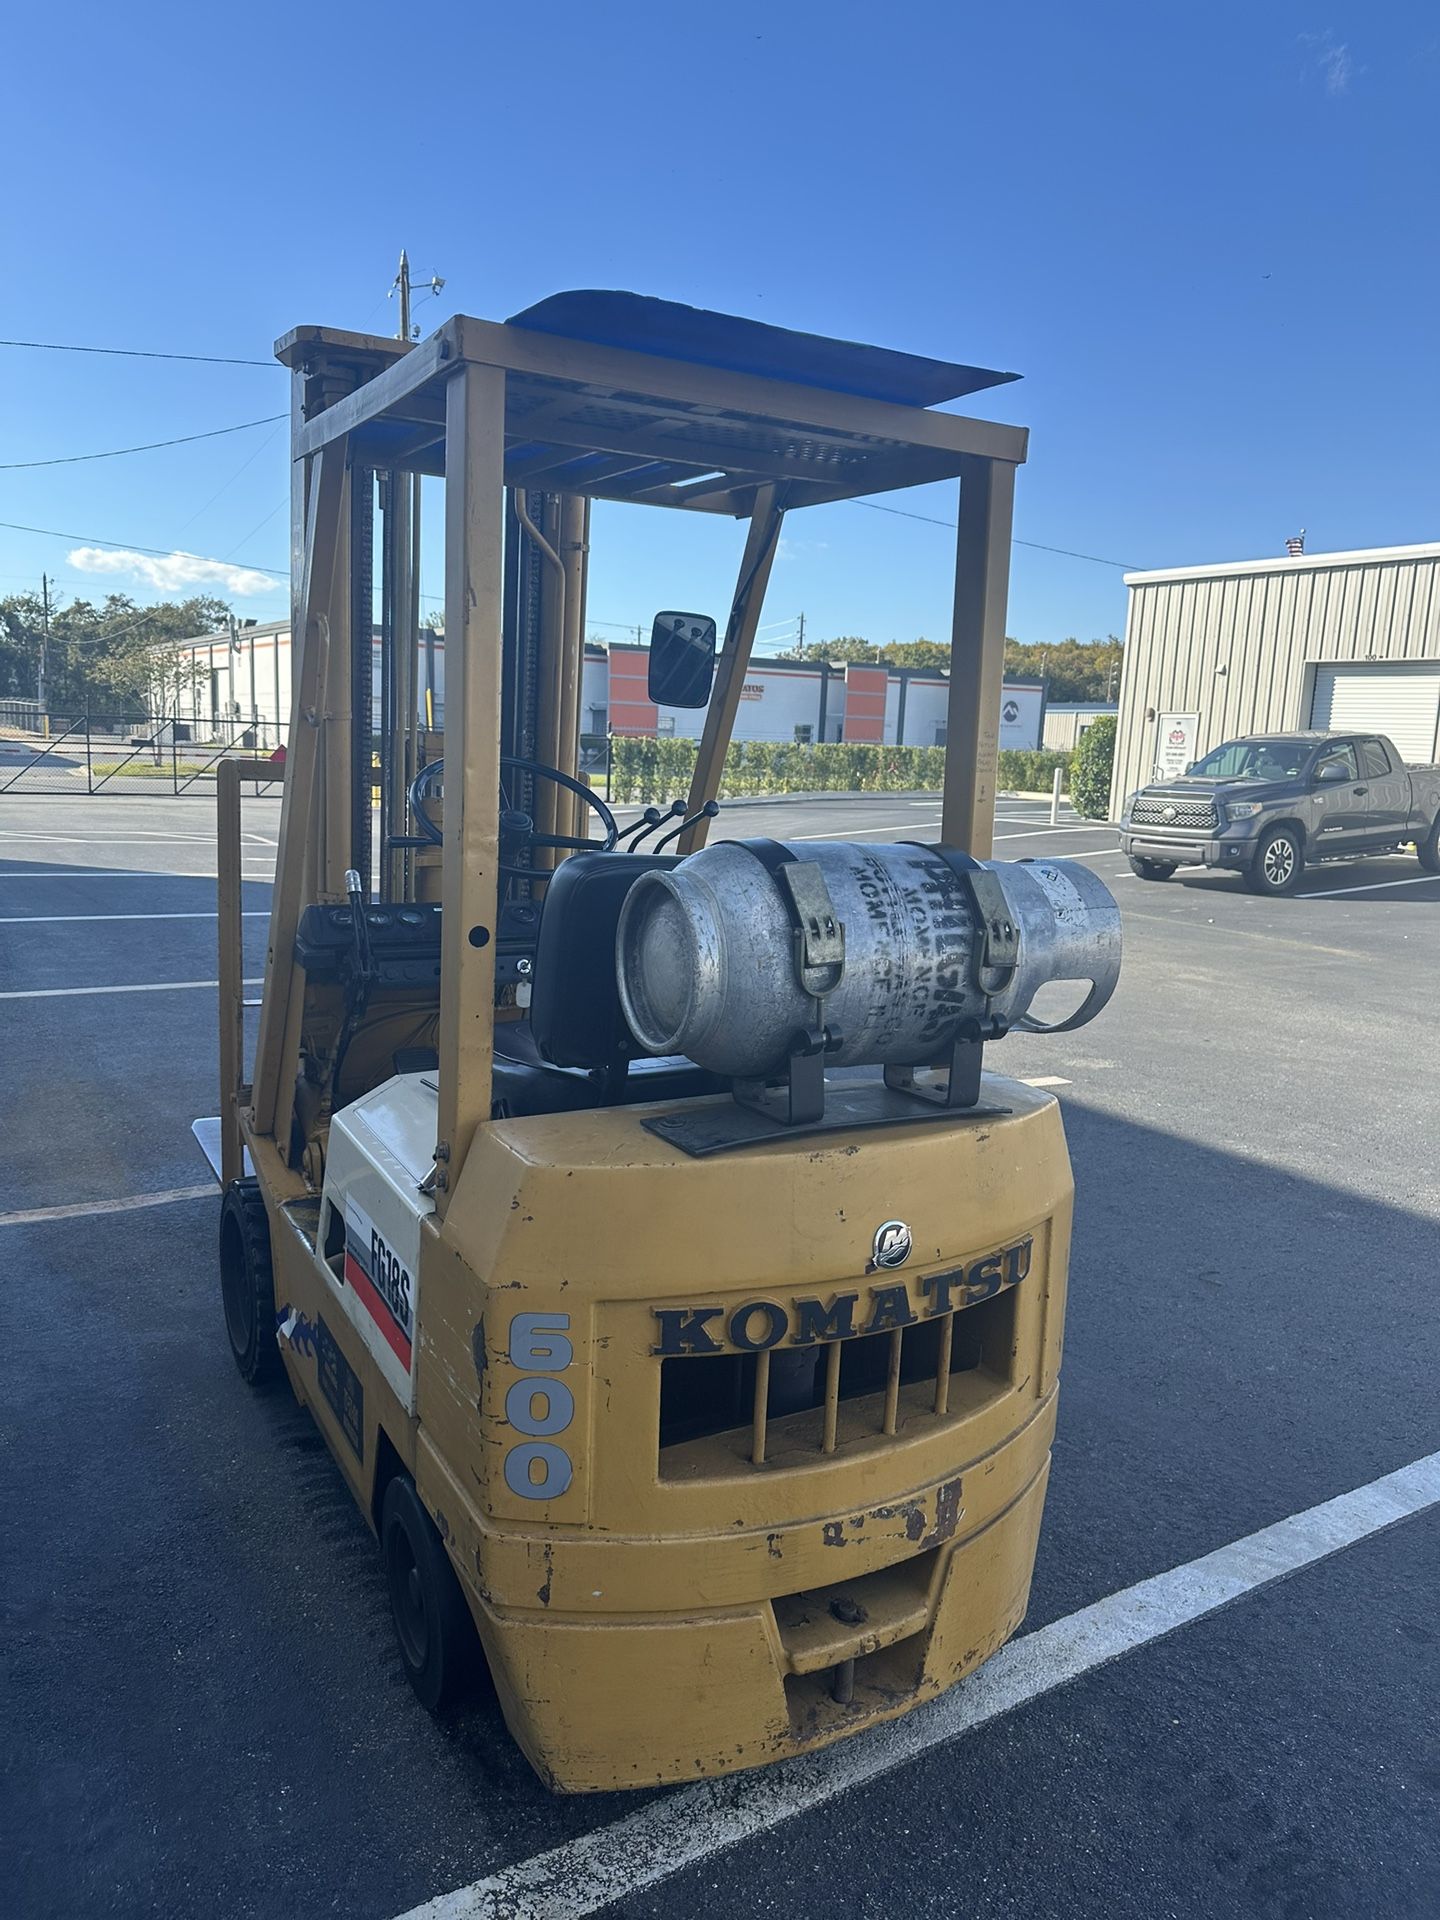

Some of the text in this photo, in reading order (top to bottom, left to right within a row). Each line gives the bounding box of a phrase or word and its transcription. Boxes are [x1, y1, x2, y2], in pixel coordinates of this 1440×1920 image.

[371, 1227, 410, 1327] FG18S
[650, 1233, 1034, 1356] KOMATSU
[504, 1312, 575, 1500] 600
